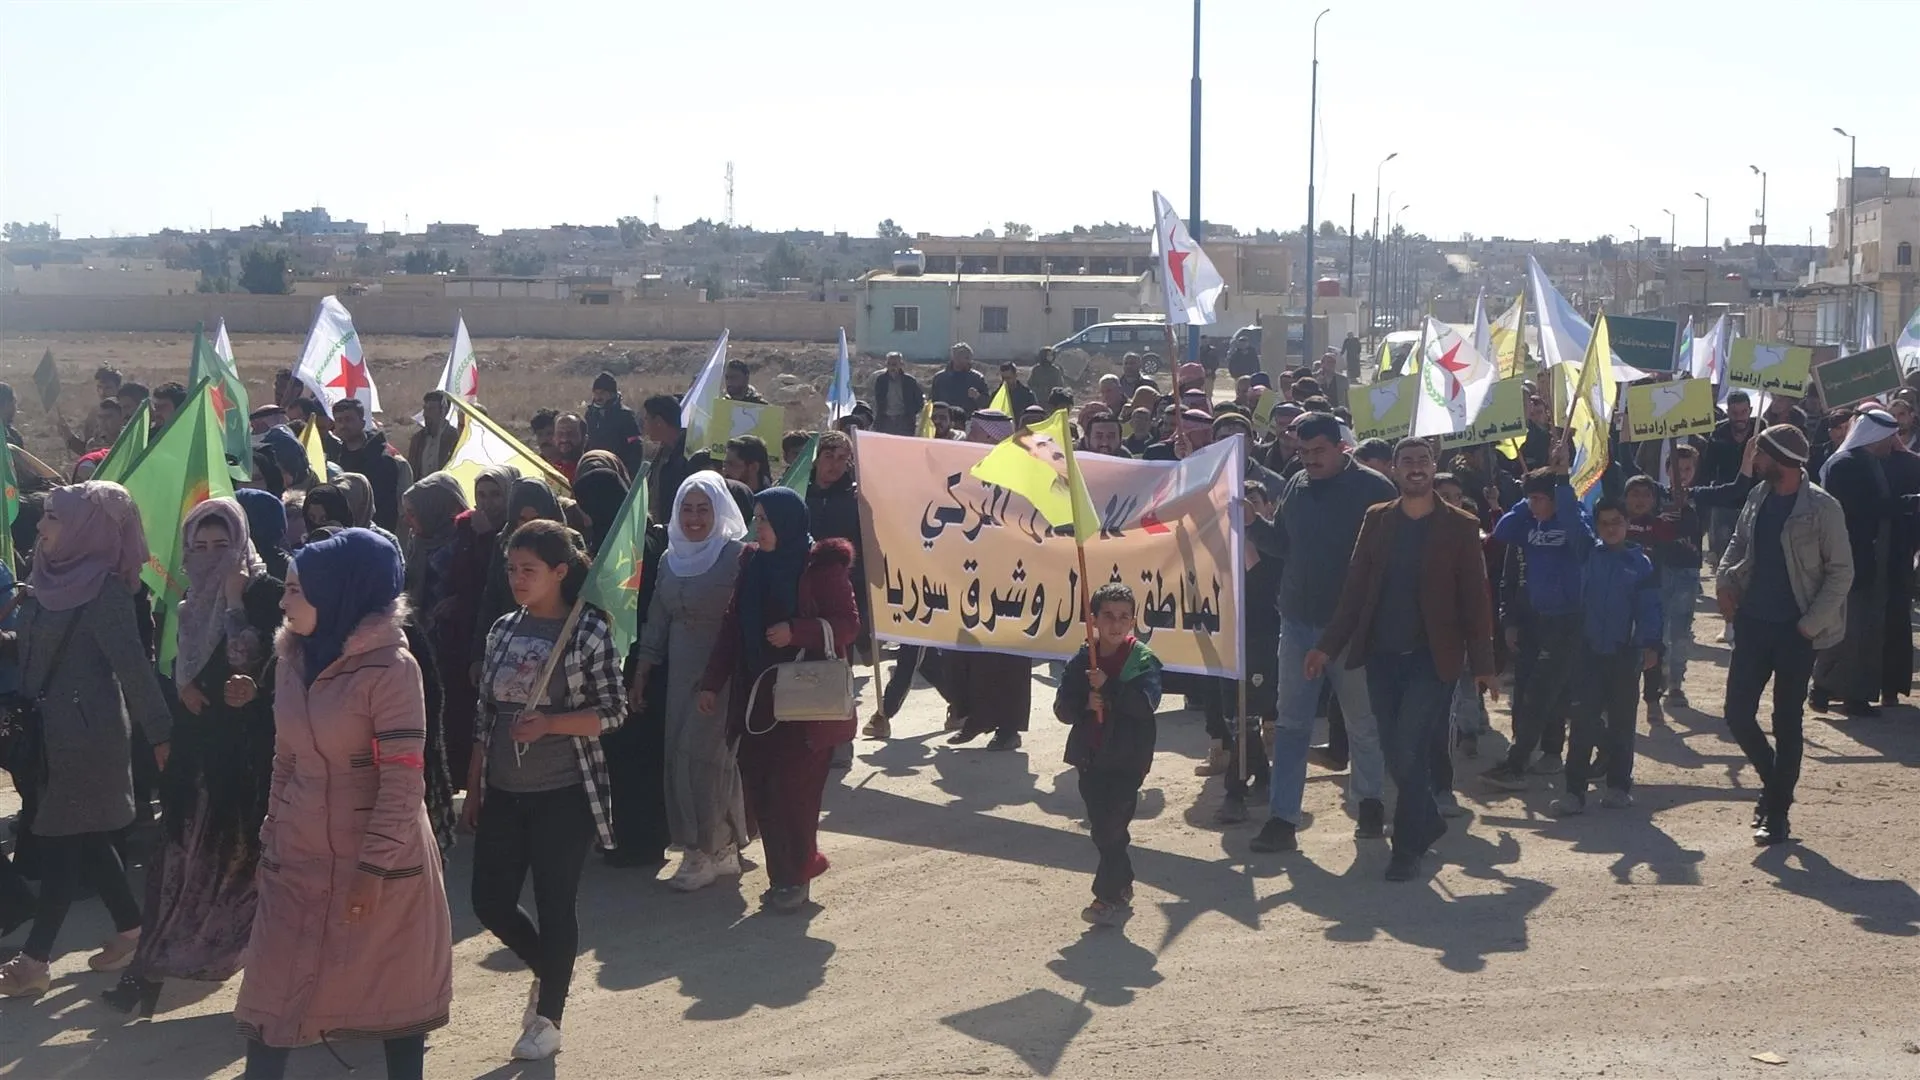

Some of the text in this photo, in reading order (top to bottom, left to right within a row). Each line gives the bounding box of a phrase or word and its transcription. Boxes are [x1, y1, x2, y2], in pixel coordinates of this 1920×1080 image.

[1762, 377, 1780, 391] هي
[1782, 378, 1803, 391] قسد
[1500, 417, 1523, 433] قسد
[1669, 418, 1688, 433] هي
[1691, 413, 1711, 425] قسد
[1478, 421, 1497, 440] هي
[920, 471, 1008, 549] التركي
[884, 552, 949, 625] سوريا
[960, 558, 1045, 637] وشرق
[1134, 569, 1221, 643] لمناطق
